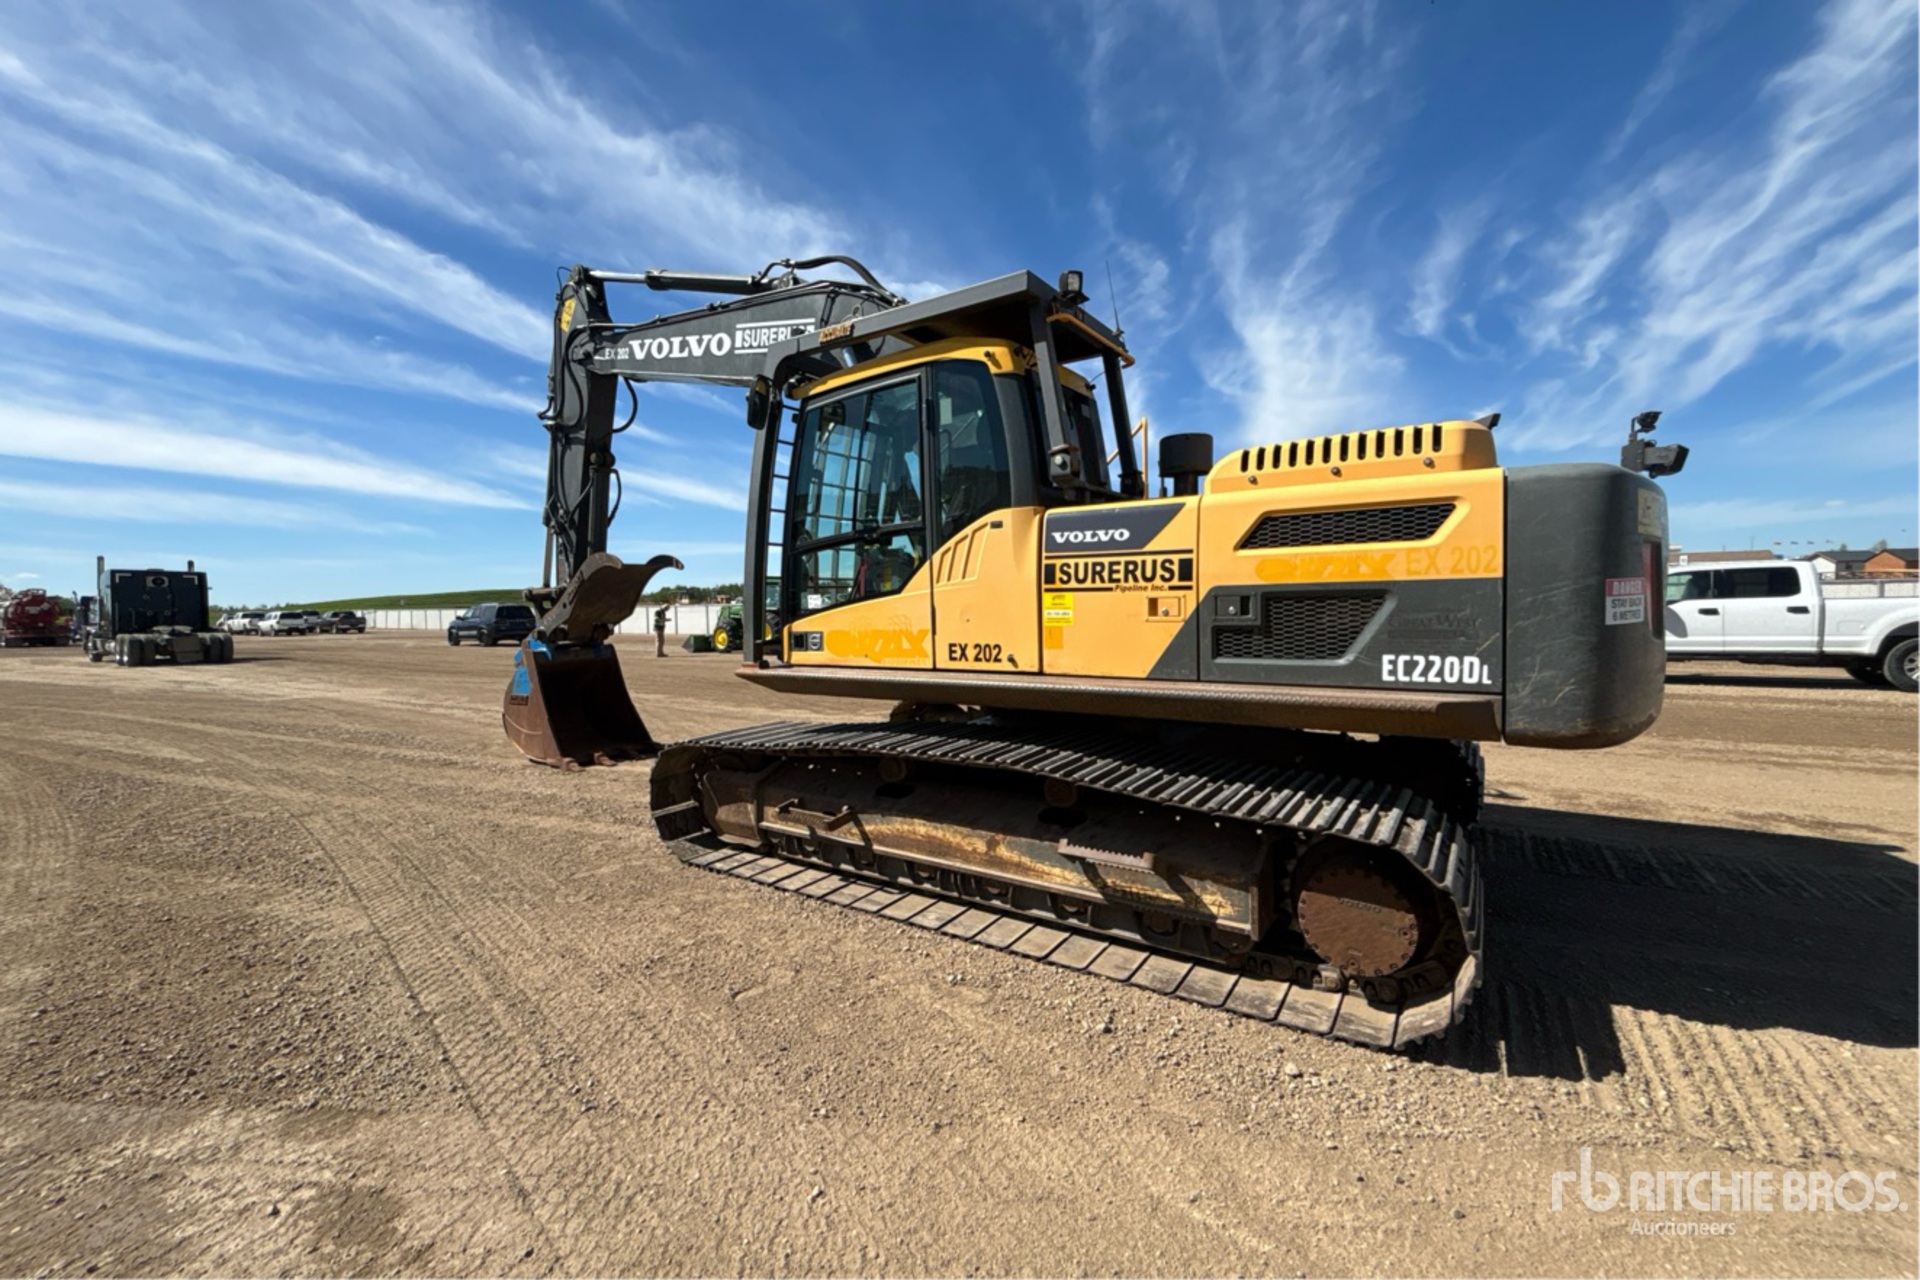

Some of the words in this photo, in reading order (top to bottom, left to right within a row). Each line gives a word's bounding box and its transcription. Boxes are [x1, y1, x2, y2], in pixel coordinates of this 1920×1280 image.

[605, 347, 615, 359] EX
[617, 347, 629, 359] 202
[629, 333, 731, 360] VOLVO
[1052, 528, 1130, 543] VOLVO
[1059, 558, 1175, 584] SURERUS
[1406, 548, 1441, 576] EX
[1451, 545, 1498, 574] 202
[1114, 585, 1148, 593] Pipeline
[1151, 583, 1168, 592] Inc.
[948, 643, 968, 661] EX
[974, 643, 1003, 662] 202
